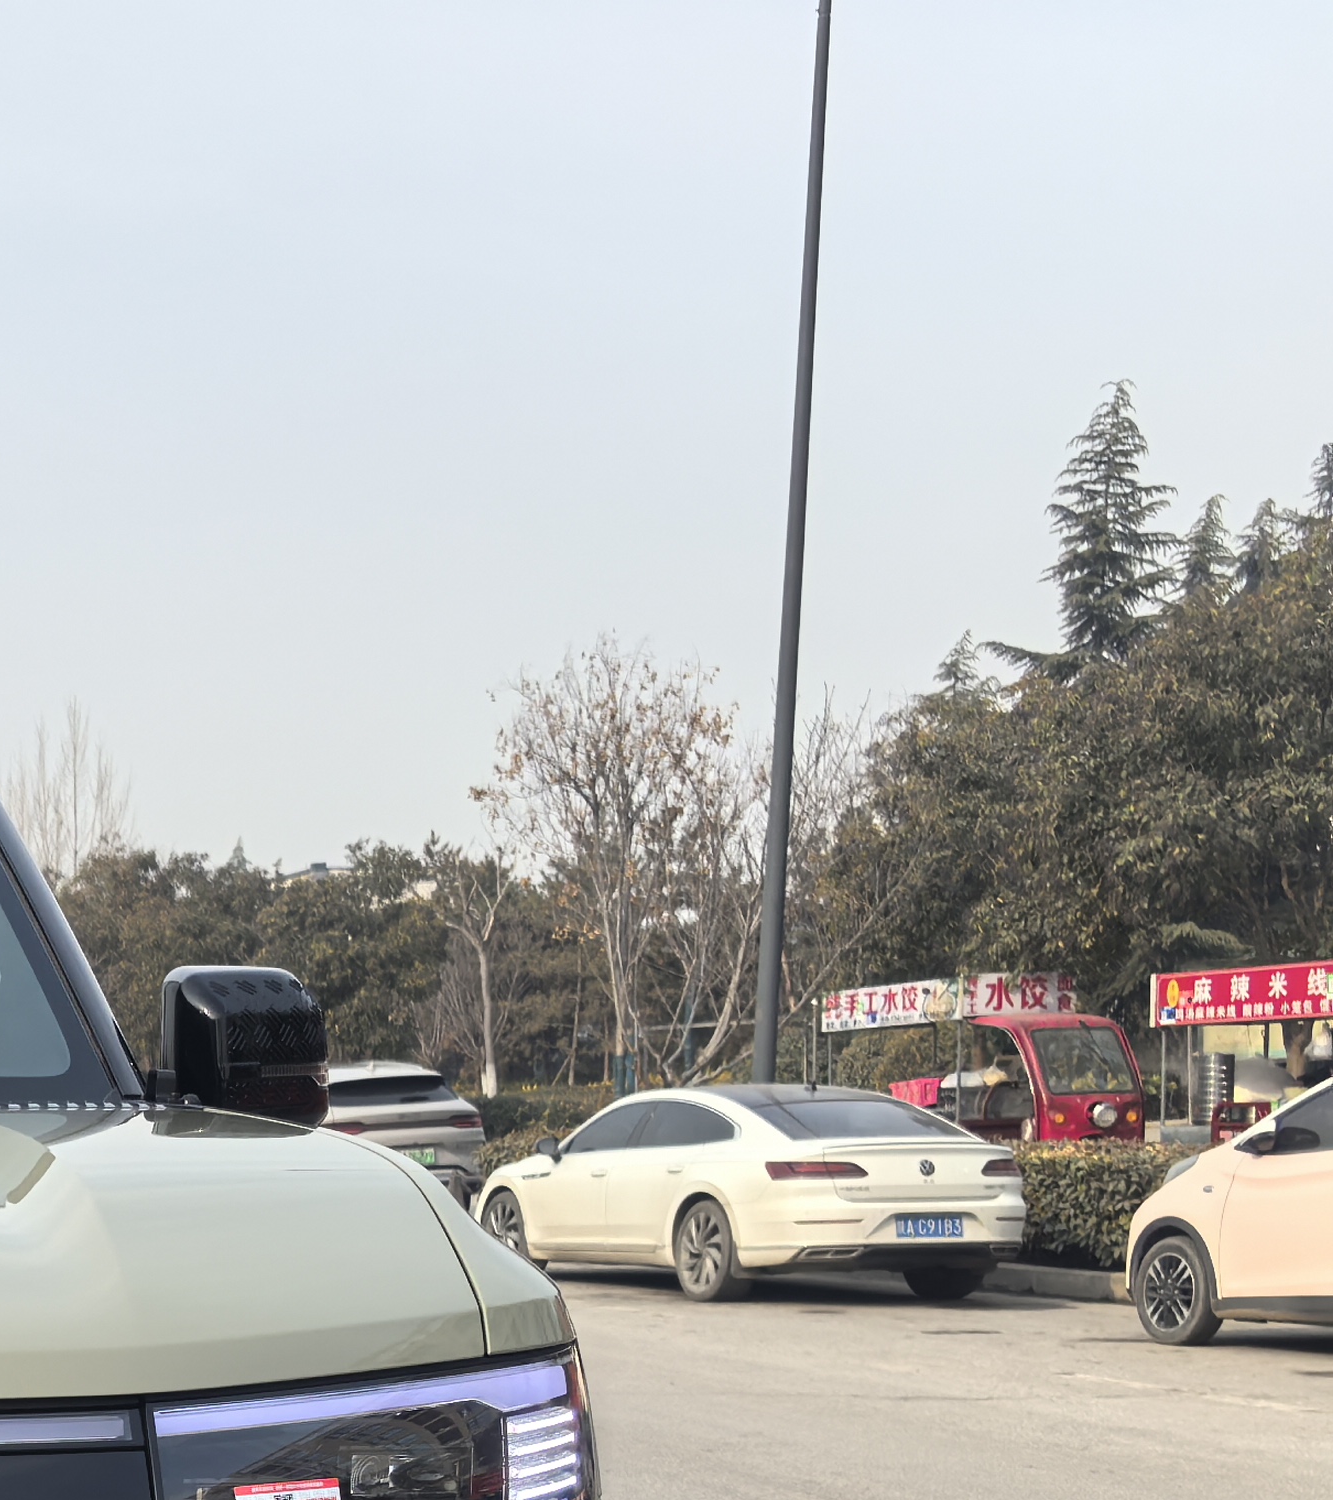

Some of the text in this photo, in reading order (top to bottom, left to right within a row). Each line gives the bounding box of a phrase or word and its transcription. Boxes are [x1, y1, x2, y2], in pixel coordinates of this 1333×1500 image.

[985, 976, 1048, 1011] 水饺
[1193, 968, 1329, 1004] 麻辣米线
